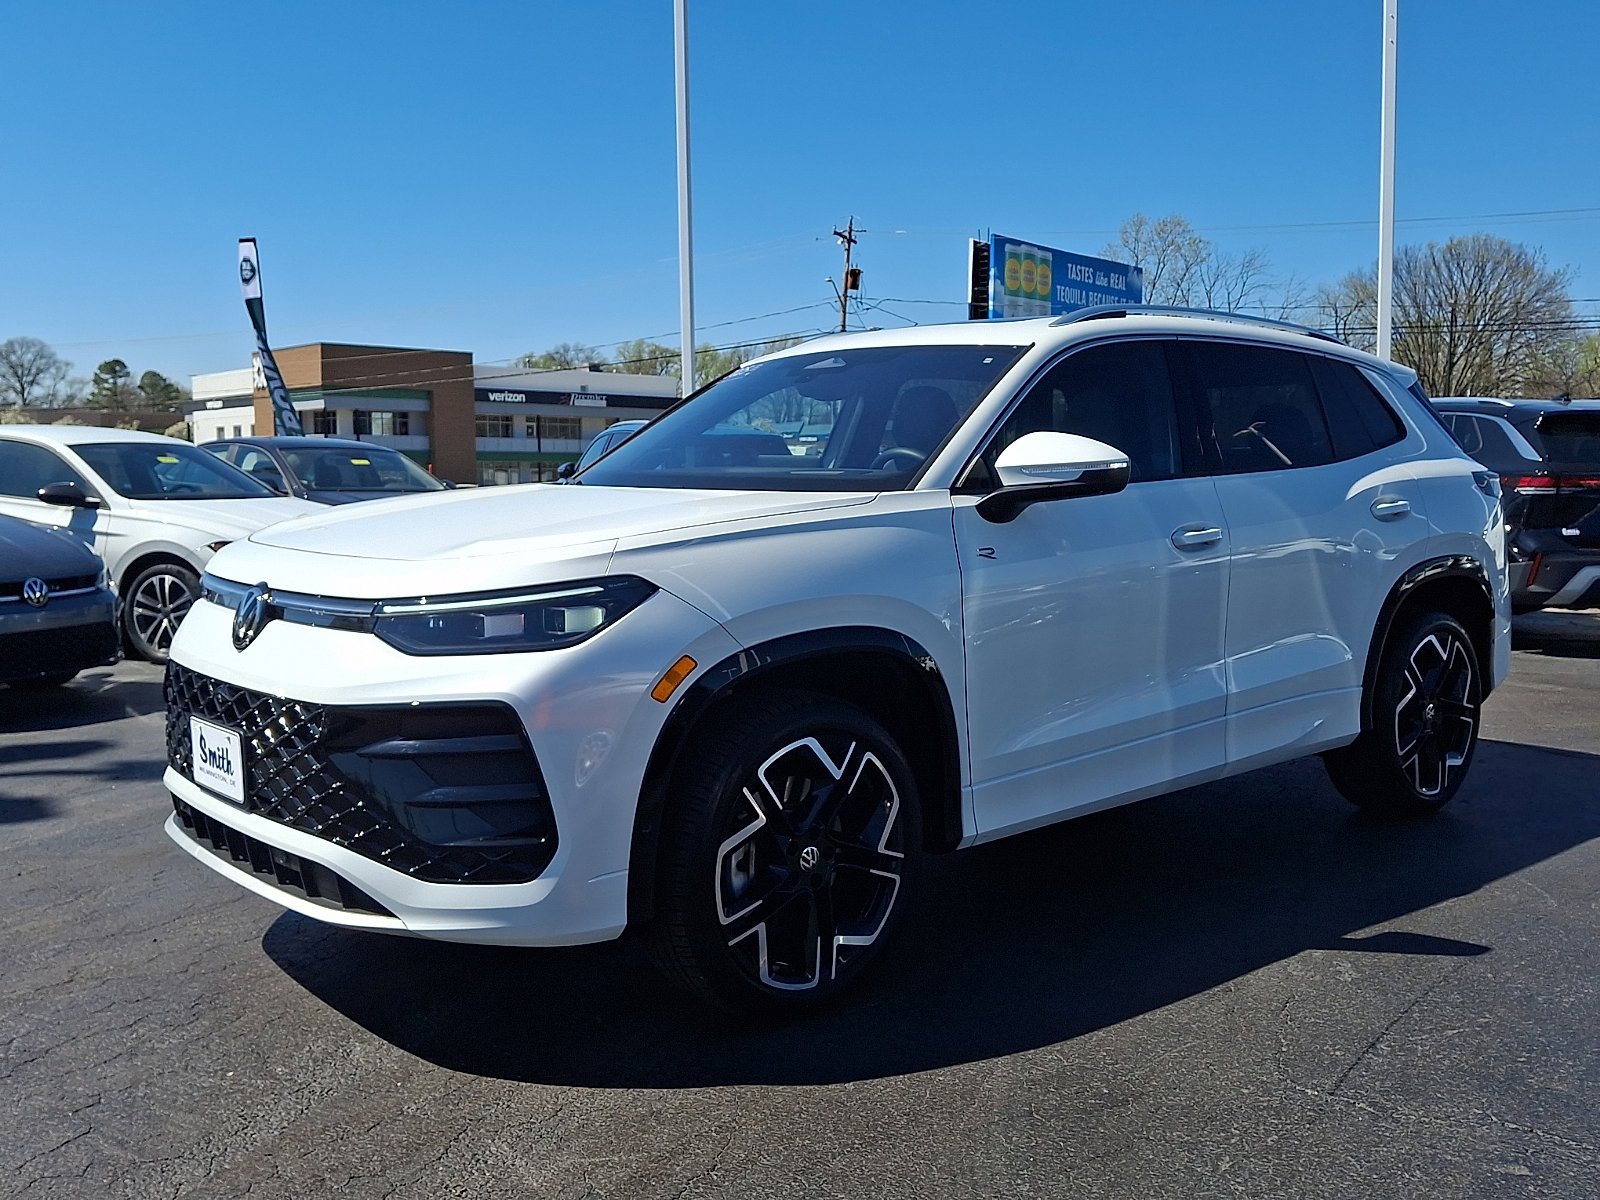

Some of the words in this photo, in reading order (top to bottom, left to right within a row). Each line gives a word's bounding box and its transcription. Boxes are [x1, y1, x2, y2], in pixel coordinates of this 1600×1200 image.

[1067, 263, 1094, 284] TASTES
[1095, 271, 1108, 287] like
[1110, 273, 1127, 291] REAL
[1056, 285, 1087, 307] TEQUILA
[1088, 291, 1118, 307] BECAUSE
[488, 391, 526, 403] verizon
[199, 733, 235, 776] Smith
